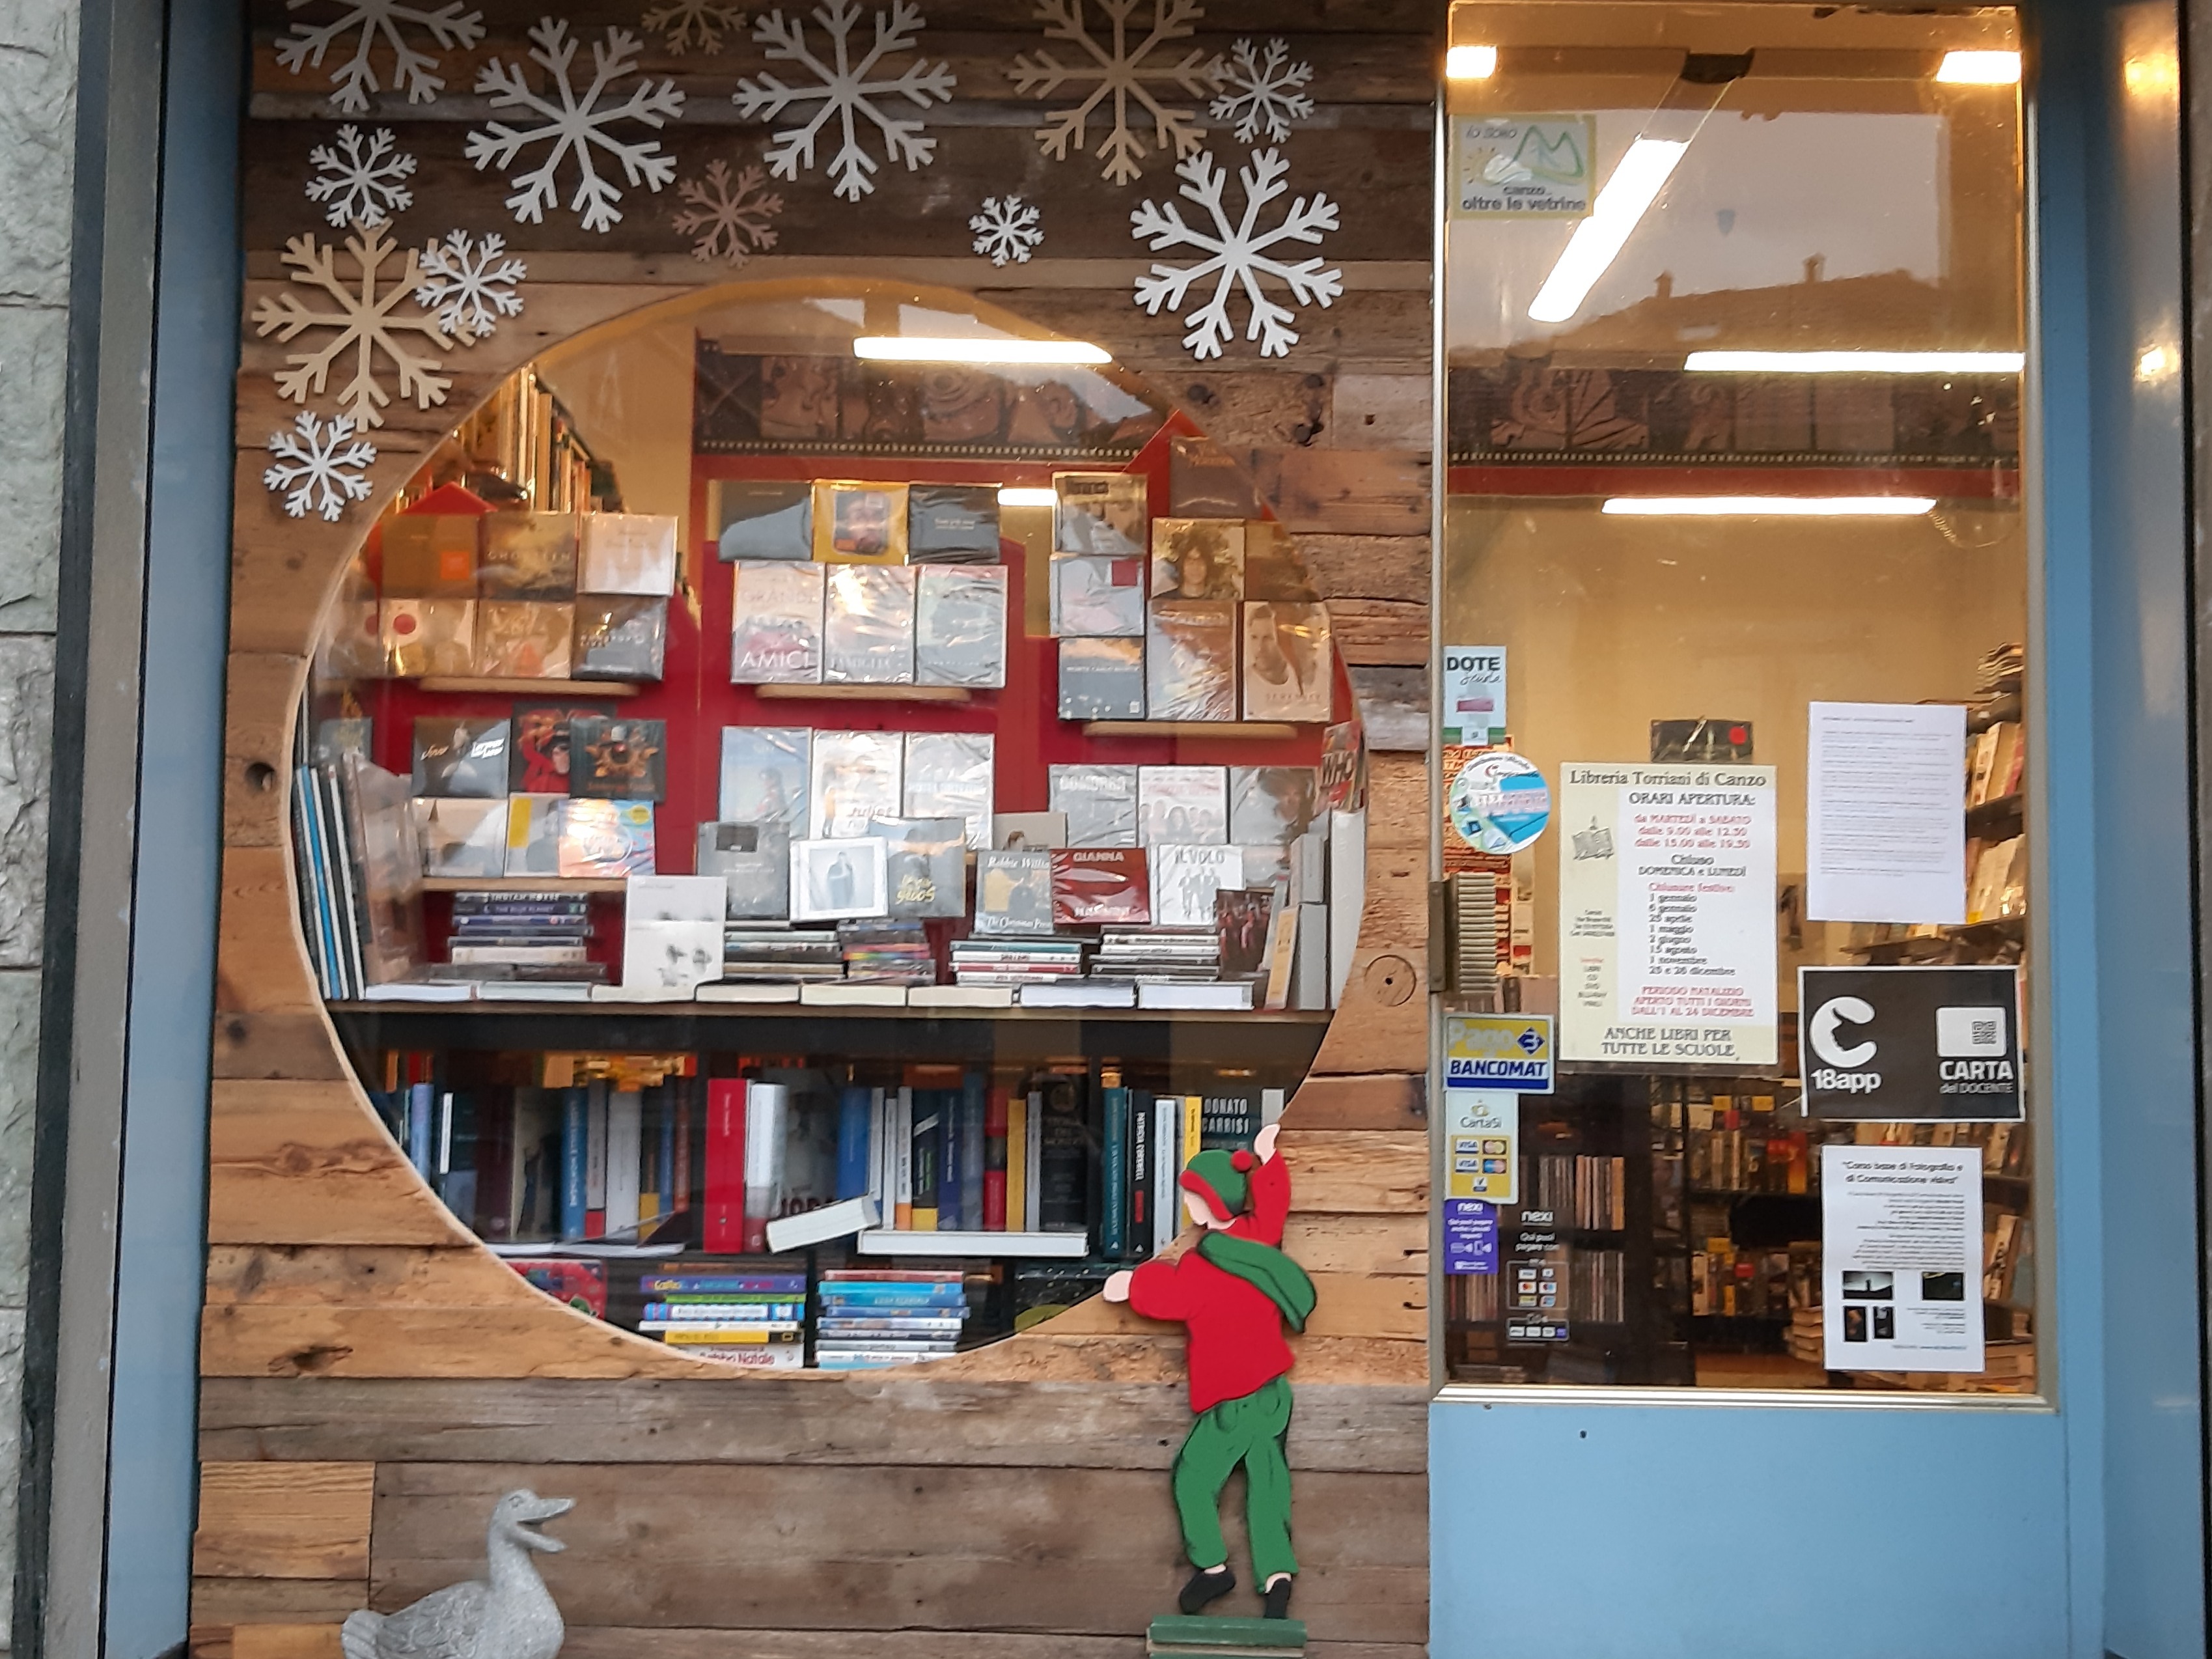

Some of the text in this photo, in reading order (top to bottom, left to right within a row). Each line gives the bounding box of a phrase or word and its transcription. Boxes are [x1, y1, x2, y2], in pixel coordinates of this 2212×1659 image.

[1463, 197, 1586, 211] oltre le vetrine
[1446, 656, 1500, 671] DOTE
[1569, 770, 1767, 786] Libreria Torriani di Canzo
[1629, 792, 1673, 804] ORARI
[1448, 1020, 1515, 1057] Pago
[1604, 1027, 1732, 1041] ANCHE LIBRI PER
[1601, 1042, 1735, 1057] TUTTE LE SCUOLE
[1450, 1060, 1547, 1076] BANCOMAT
[1939, 1061, 2013, 1080] CARTA
[1810, 1069, 1882, 1094] 18app
[1941, 1083, 2013, 1093] del DOCENTE
[1204, 1098, 1247, 1114] DONATO
[1458, 1203, 1484, 1212] nexi
[1521, 1211, 1554, 1222] nexi
